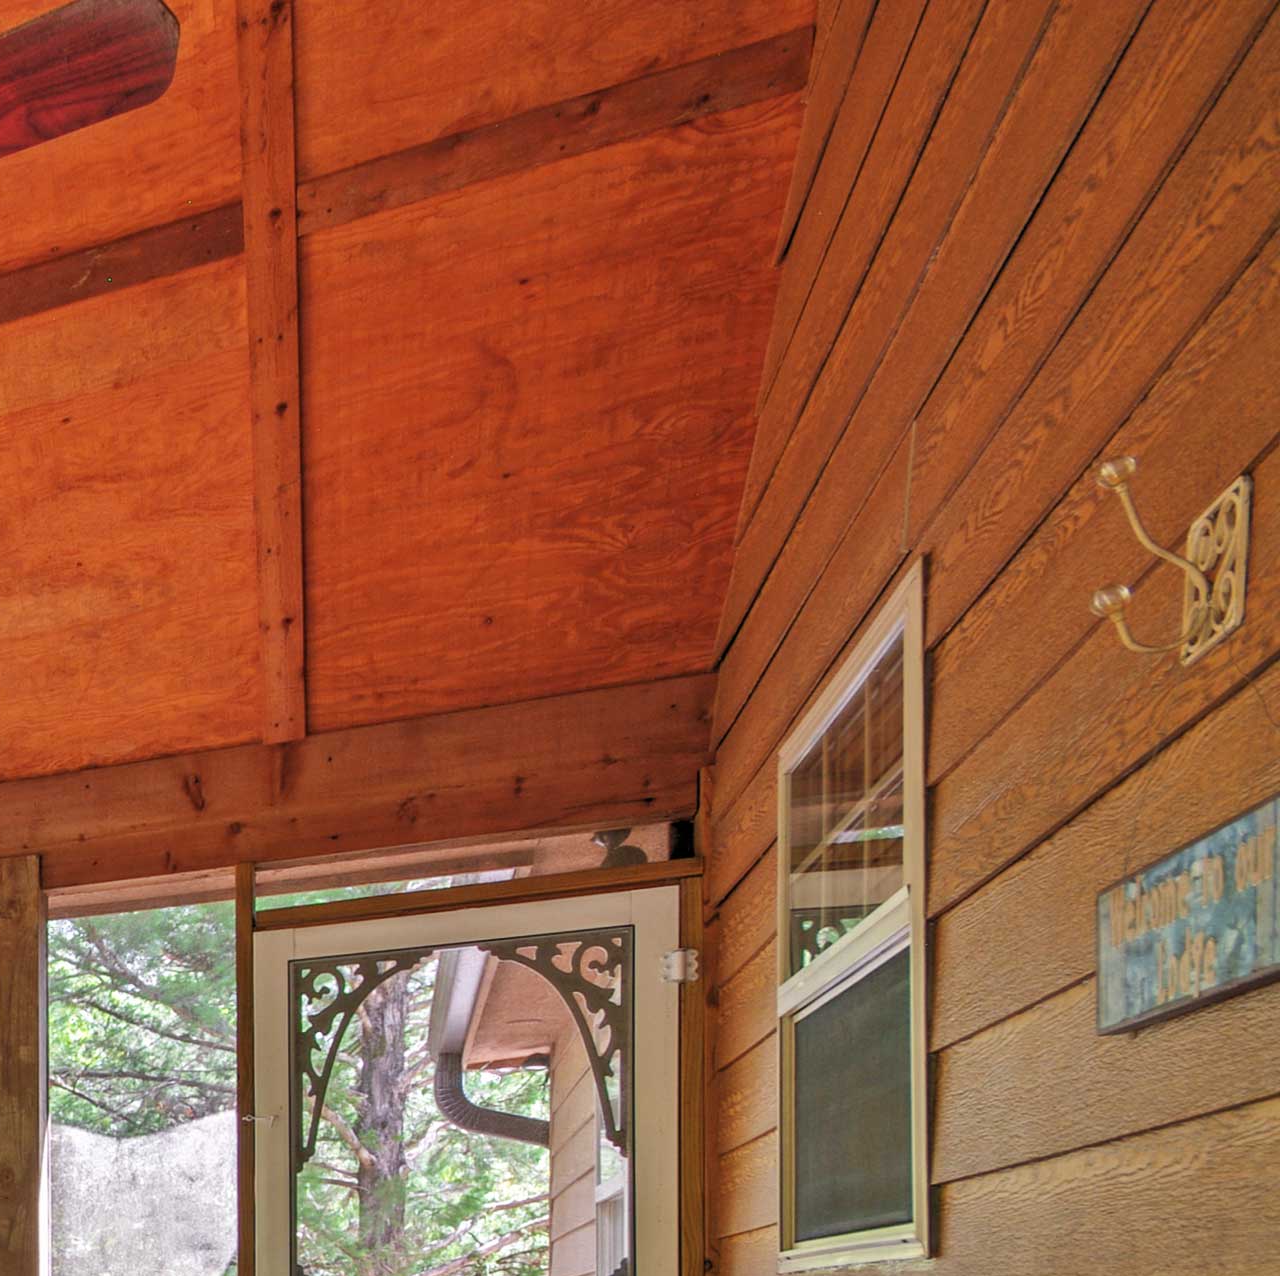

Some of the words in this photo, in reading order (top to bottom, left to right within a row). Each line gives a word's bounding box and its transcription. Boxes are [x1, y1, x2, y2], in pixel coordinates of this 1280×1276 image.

[1110, 870, 1190, 949] Welcome
[1235, 827, 1276, 893] our
[1155, 925, 1217, 1005] Lodge
